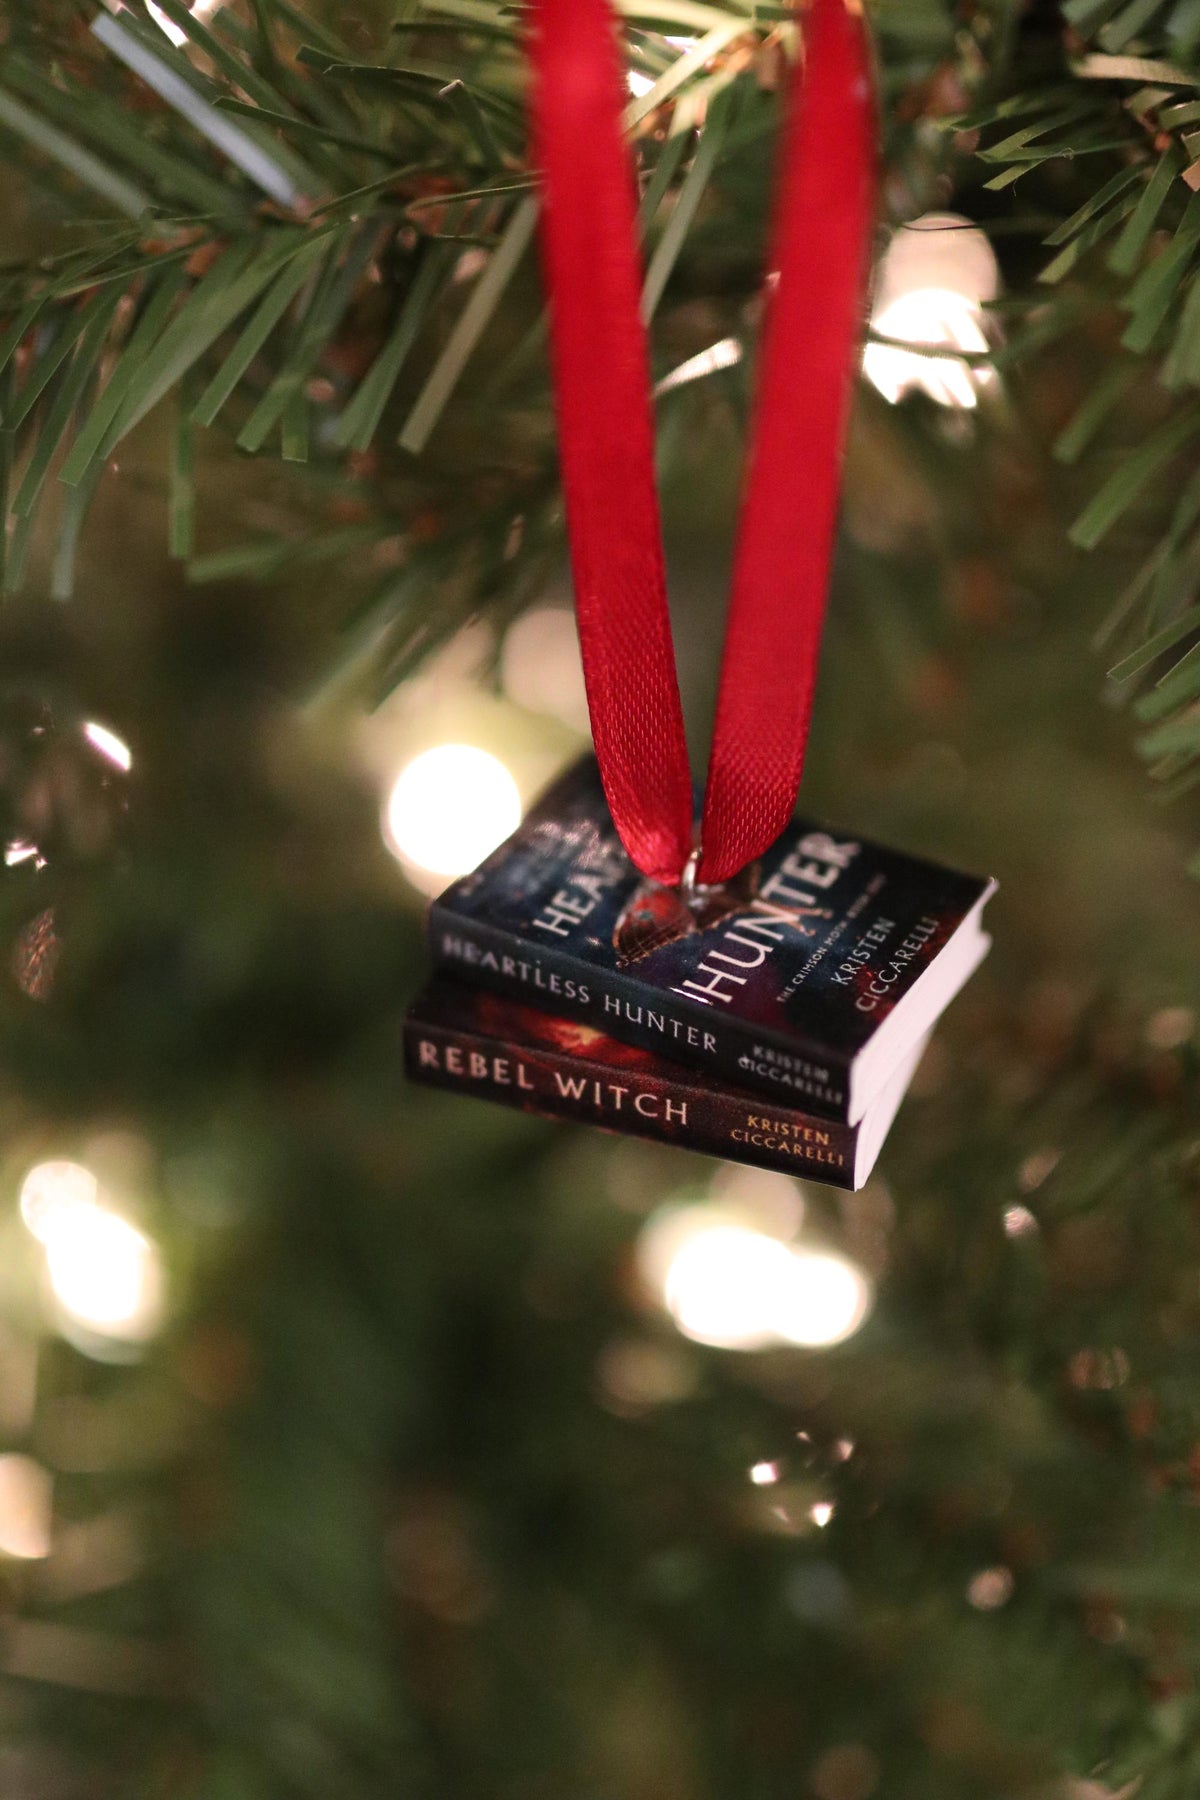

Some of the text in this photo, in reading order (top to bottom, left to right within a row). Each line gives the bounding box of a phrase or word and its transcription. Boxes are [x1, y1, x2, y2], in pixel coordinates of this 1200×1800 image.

[683, 832, 860, 1003] HUNTER
[830, 916, 896, 986] KRISTEN
[442, 934, 717, 1053] HEARTLESS HUNTER
[792, 946, 828, 986] CRIMSON
[855, 916, 939, 1012] CICCARELLI
[419, 1040, 687, 1125] REBEL WITCH
[730, 1129, 844, 1166] CICCARELLI
[747, 1115, 829, 1145] KRISTEN
